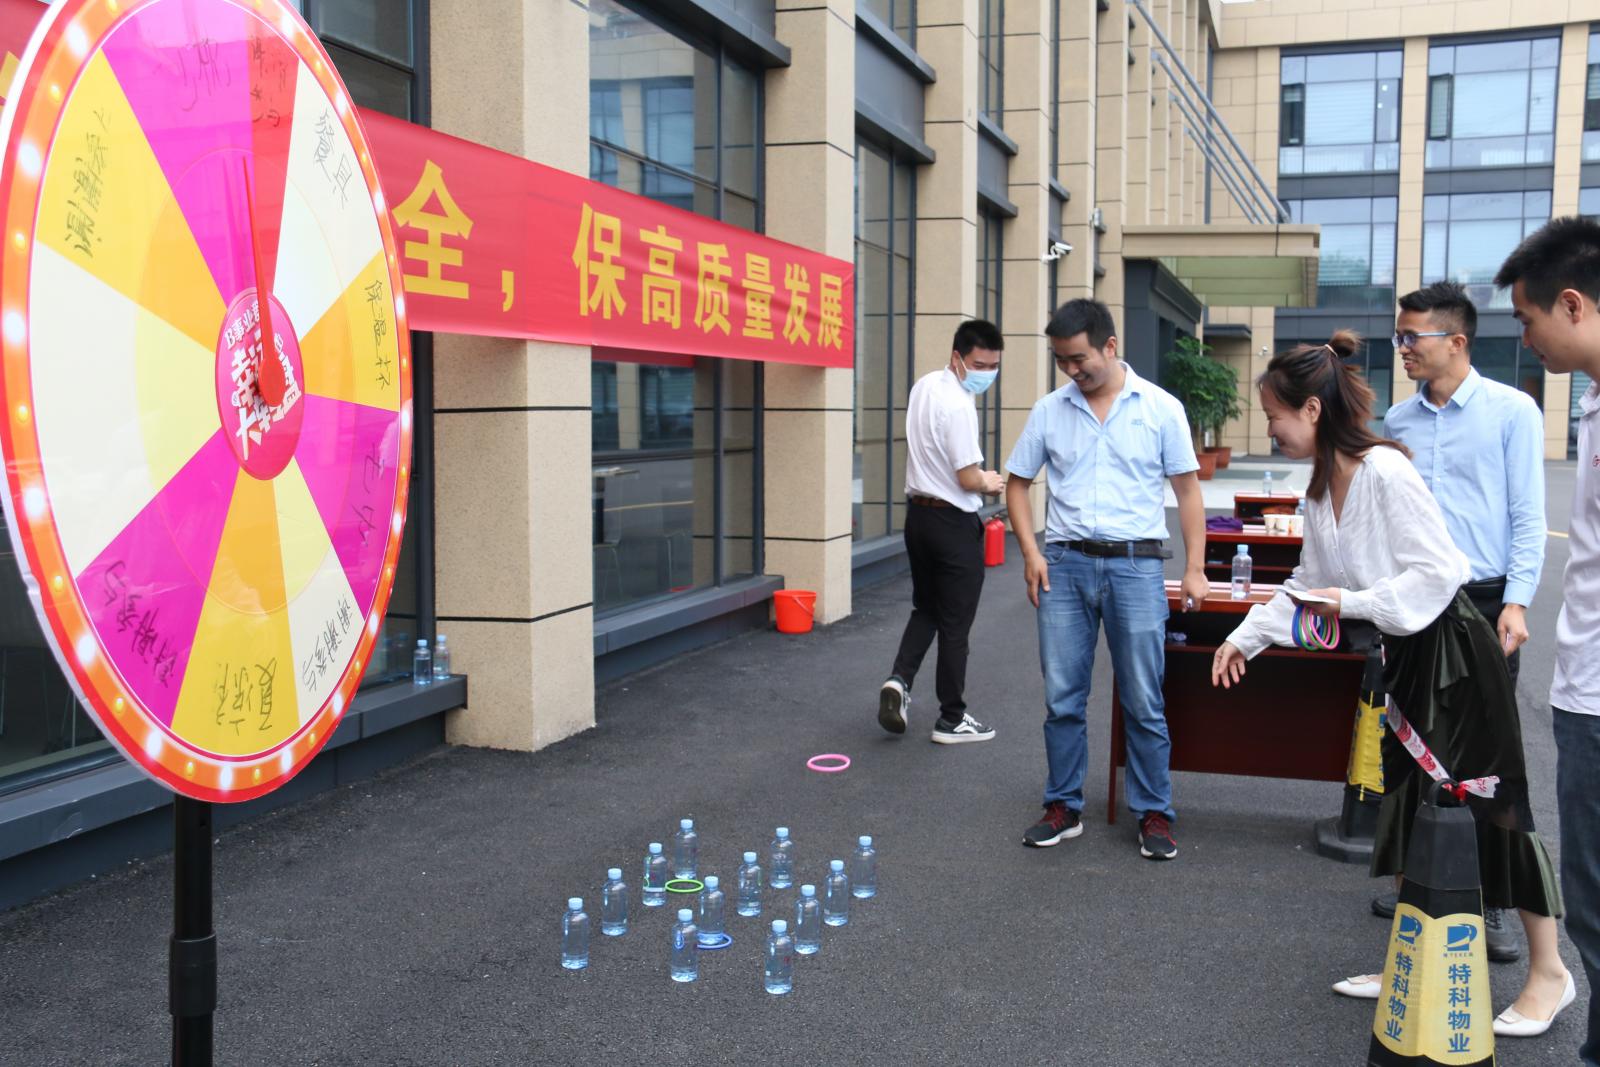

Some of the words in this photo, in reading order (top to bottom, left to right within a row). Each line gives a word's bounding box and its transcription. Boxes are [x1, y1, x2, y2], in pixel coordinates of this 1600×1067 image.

[1384, 952, 1413, 1042] 特科物业
[1447, 963, 1472, 1053] 特科物业
